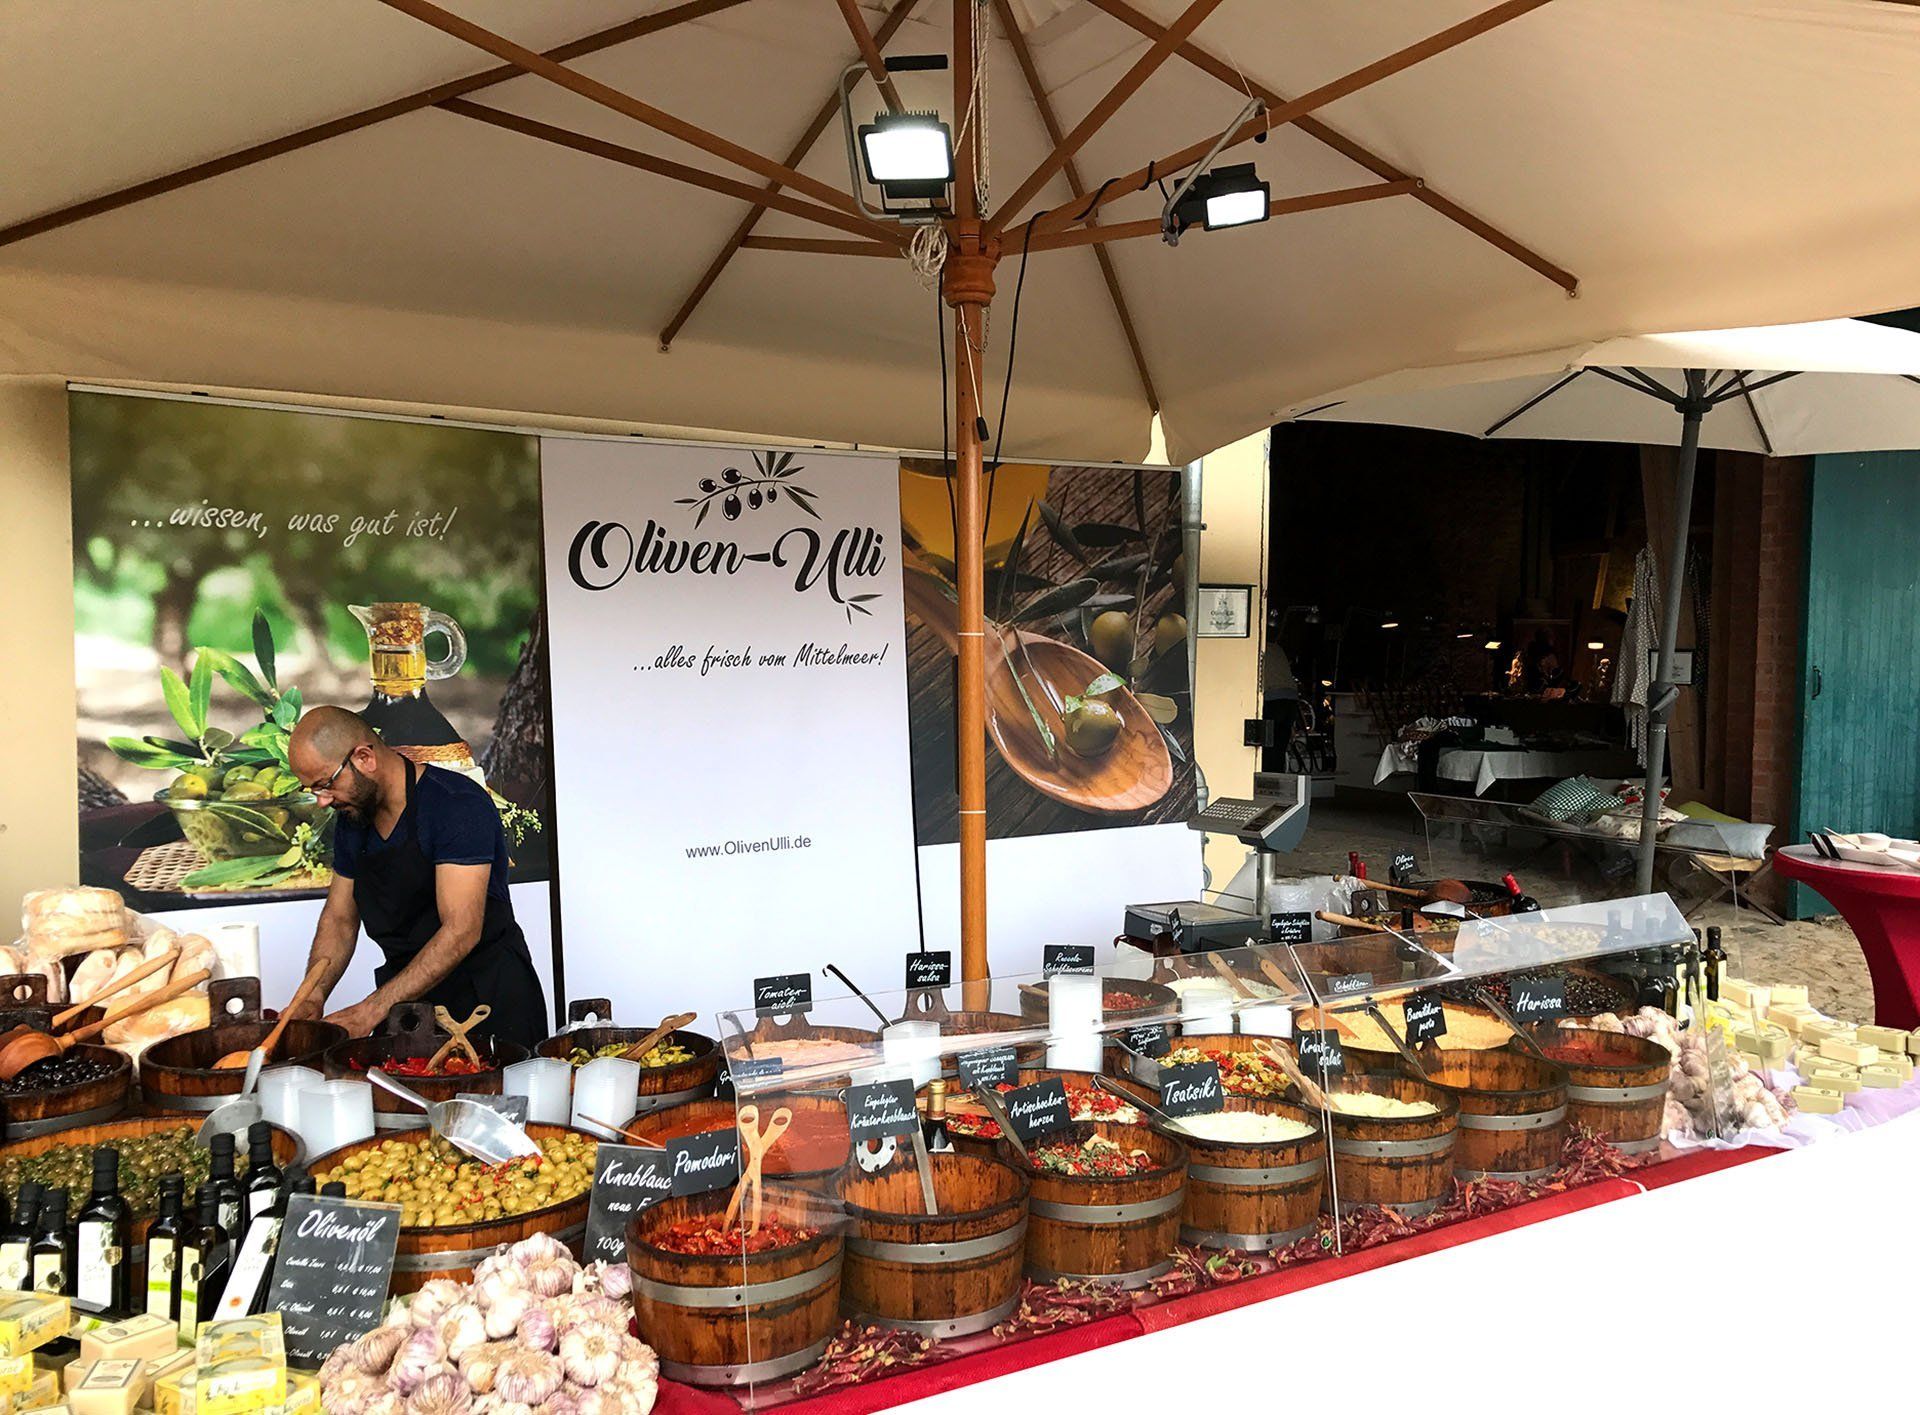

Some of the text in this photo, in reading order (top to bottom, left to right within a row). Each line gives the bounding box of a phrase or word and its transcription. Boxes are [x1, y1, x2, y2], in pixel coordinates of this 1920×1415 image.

[131, 499, 457, 547] ...wissen, was gut ist!
[567, 519, 886, 604] Oliven-Ulli
[633, 642, 889, 677] ...alles frisch vom Mittelmeer!
[685, 835, 812, 858] www.OlivenUlli.de
[909, 958, 949, 972] Harissa-
[916, 970, 941, 983] salsa
[758, 985, 808, 1001] Tomaten-
[771, 997, 797, 1010] aioli
[1516, 991, 1562, 1013] Harissa
[1164, 1075, 1218, 1106] Tsatsiki
[1010, 1091, 1066, 1119] Artischocken-
[1028, 1113, 1055, 1129] herzen
[673, 1144, 738, 1177] Pomodori
[607, 1201, 632, 1212] neue
[296, 1208, 388, 1243] Olivenöl
